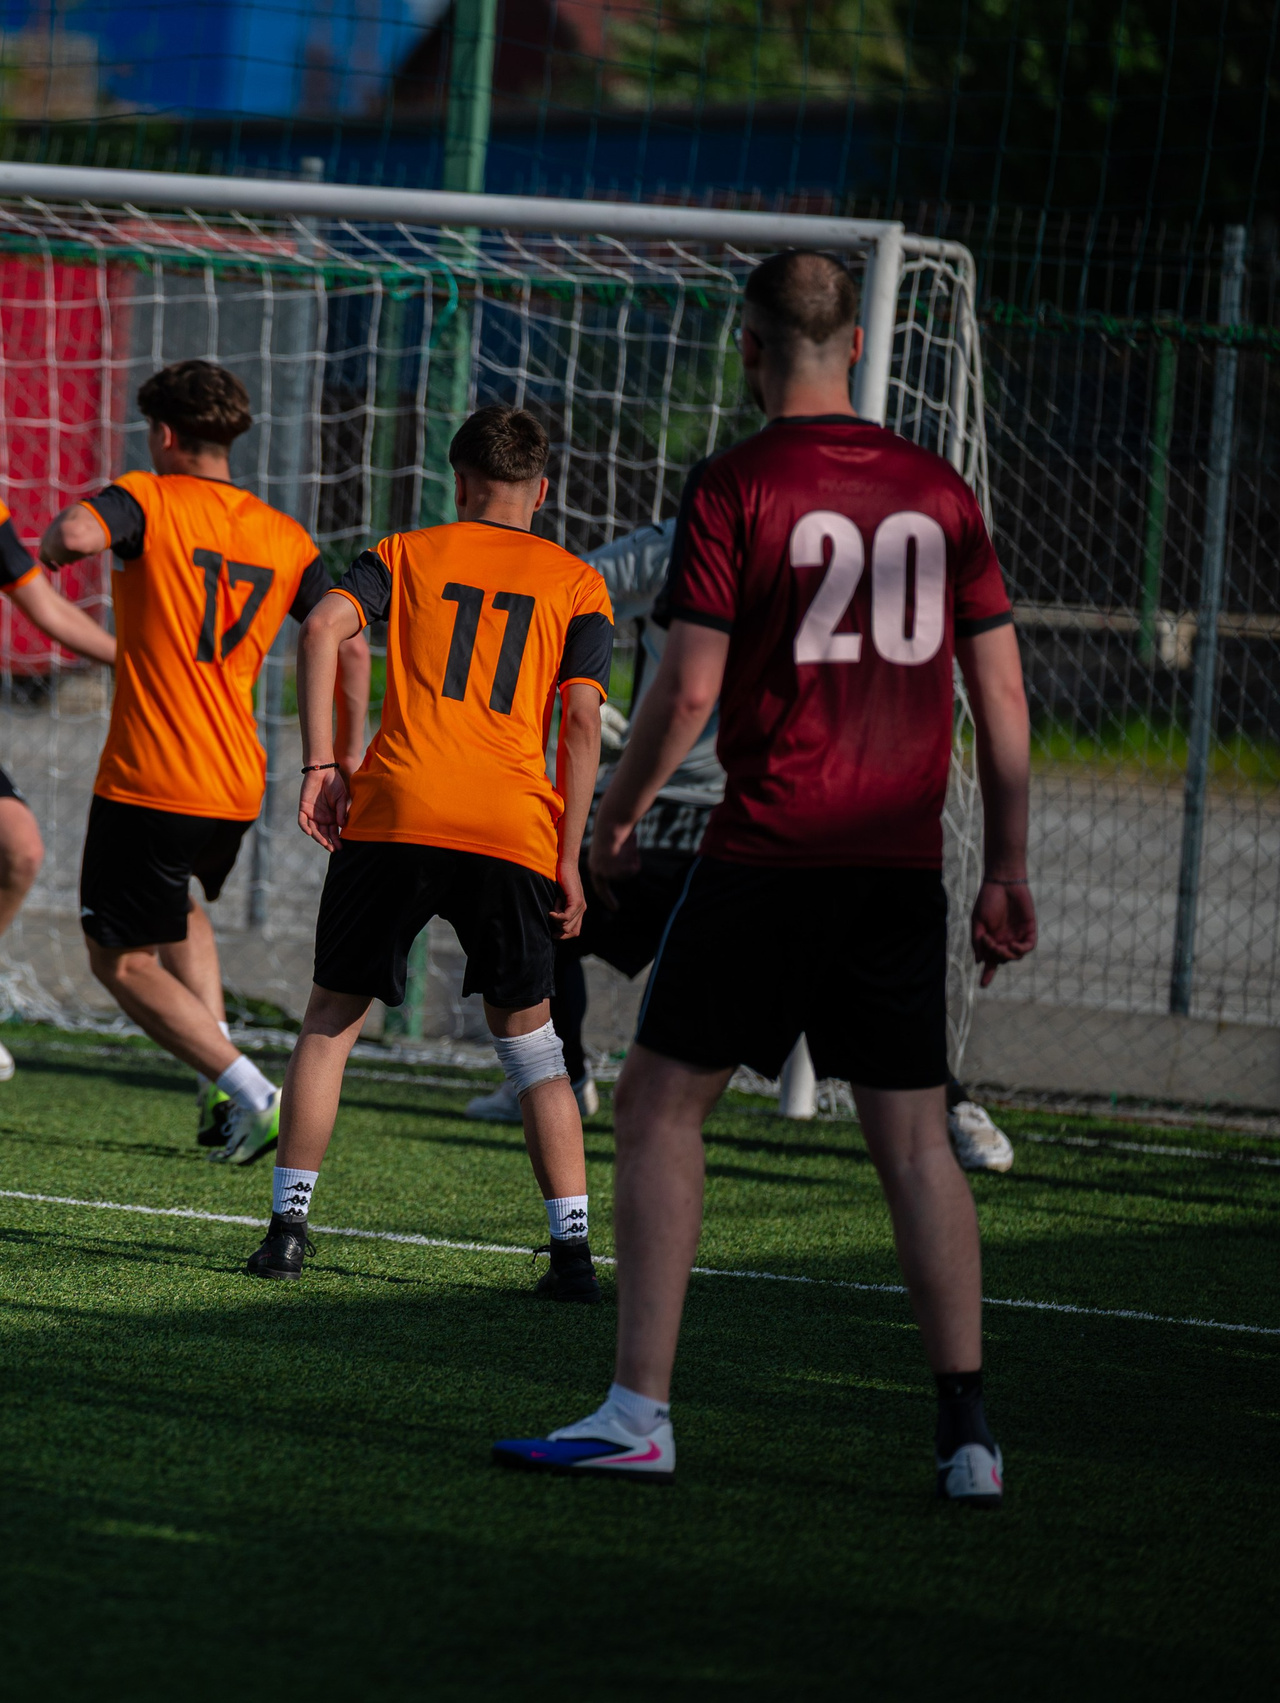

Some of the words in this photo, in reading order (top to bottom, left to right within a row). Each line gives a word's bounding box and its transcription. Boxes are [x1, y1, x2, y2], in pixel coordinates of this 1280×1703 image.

[193, 547, 274, 663] 17
[441, 582, 536, 715] 11
[790, 511, 947, 666] 20
